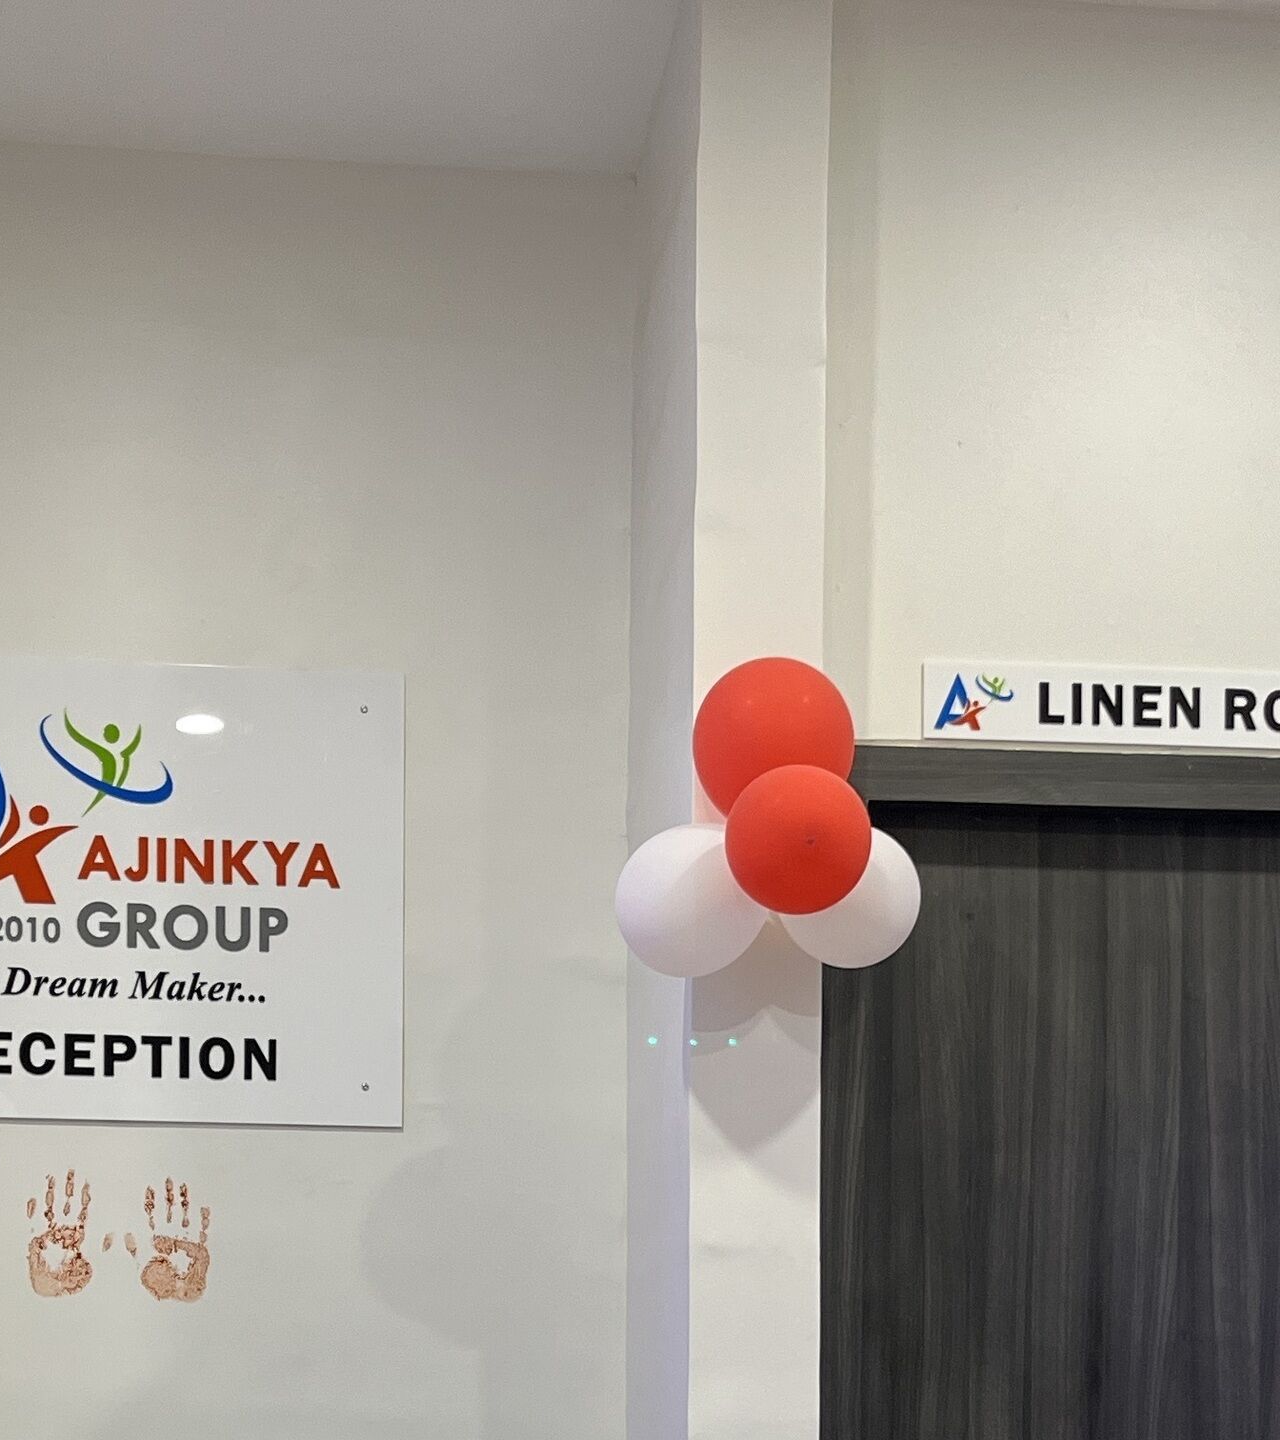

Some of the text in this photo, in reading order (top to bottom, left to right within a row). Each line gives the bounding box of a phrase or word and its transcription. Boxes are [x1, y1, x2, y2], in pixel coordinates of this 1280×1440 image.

[1037, 681, 1202, 729] LINEN
[77, 834, 341, 889] AJINKYA
[76, 901, 290, 953] GROUP
[0, 966, 120, 1000] Dream
[127, 970, 267, 1004] Maker...
